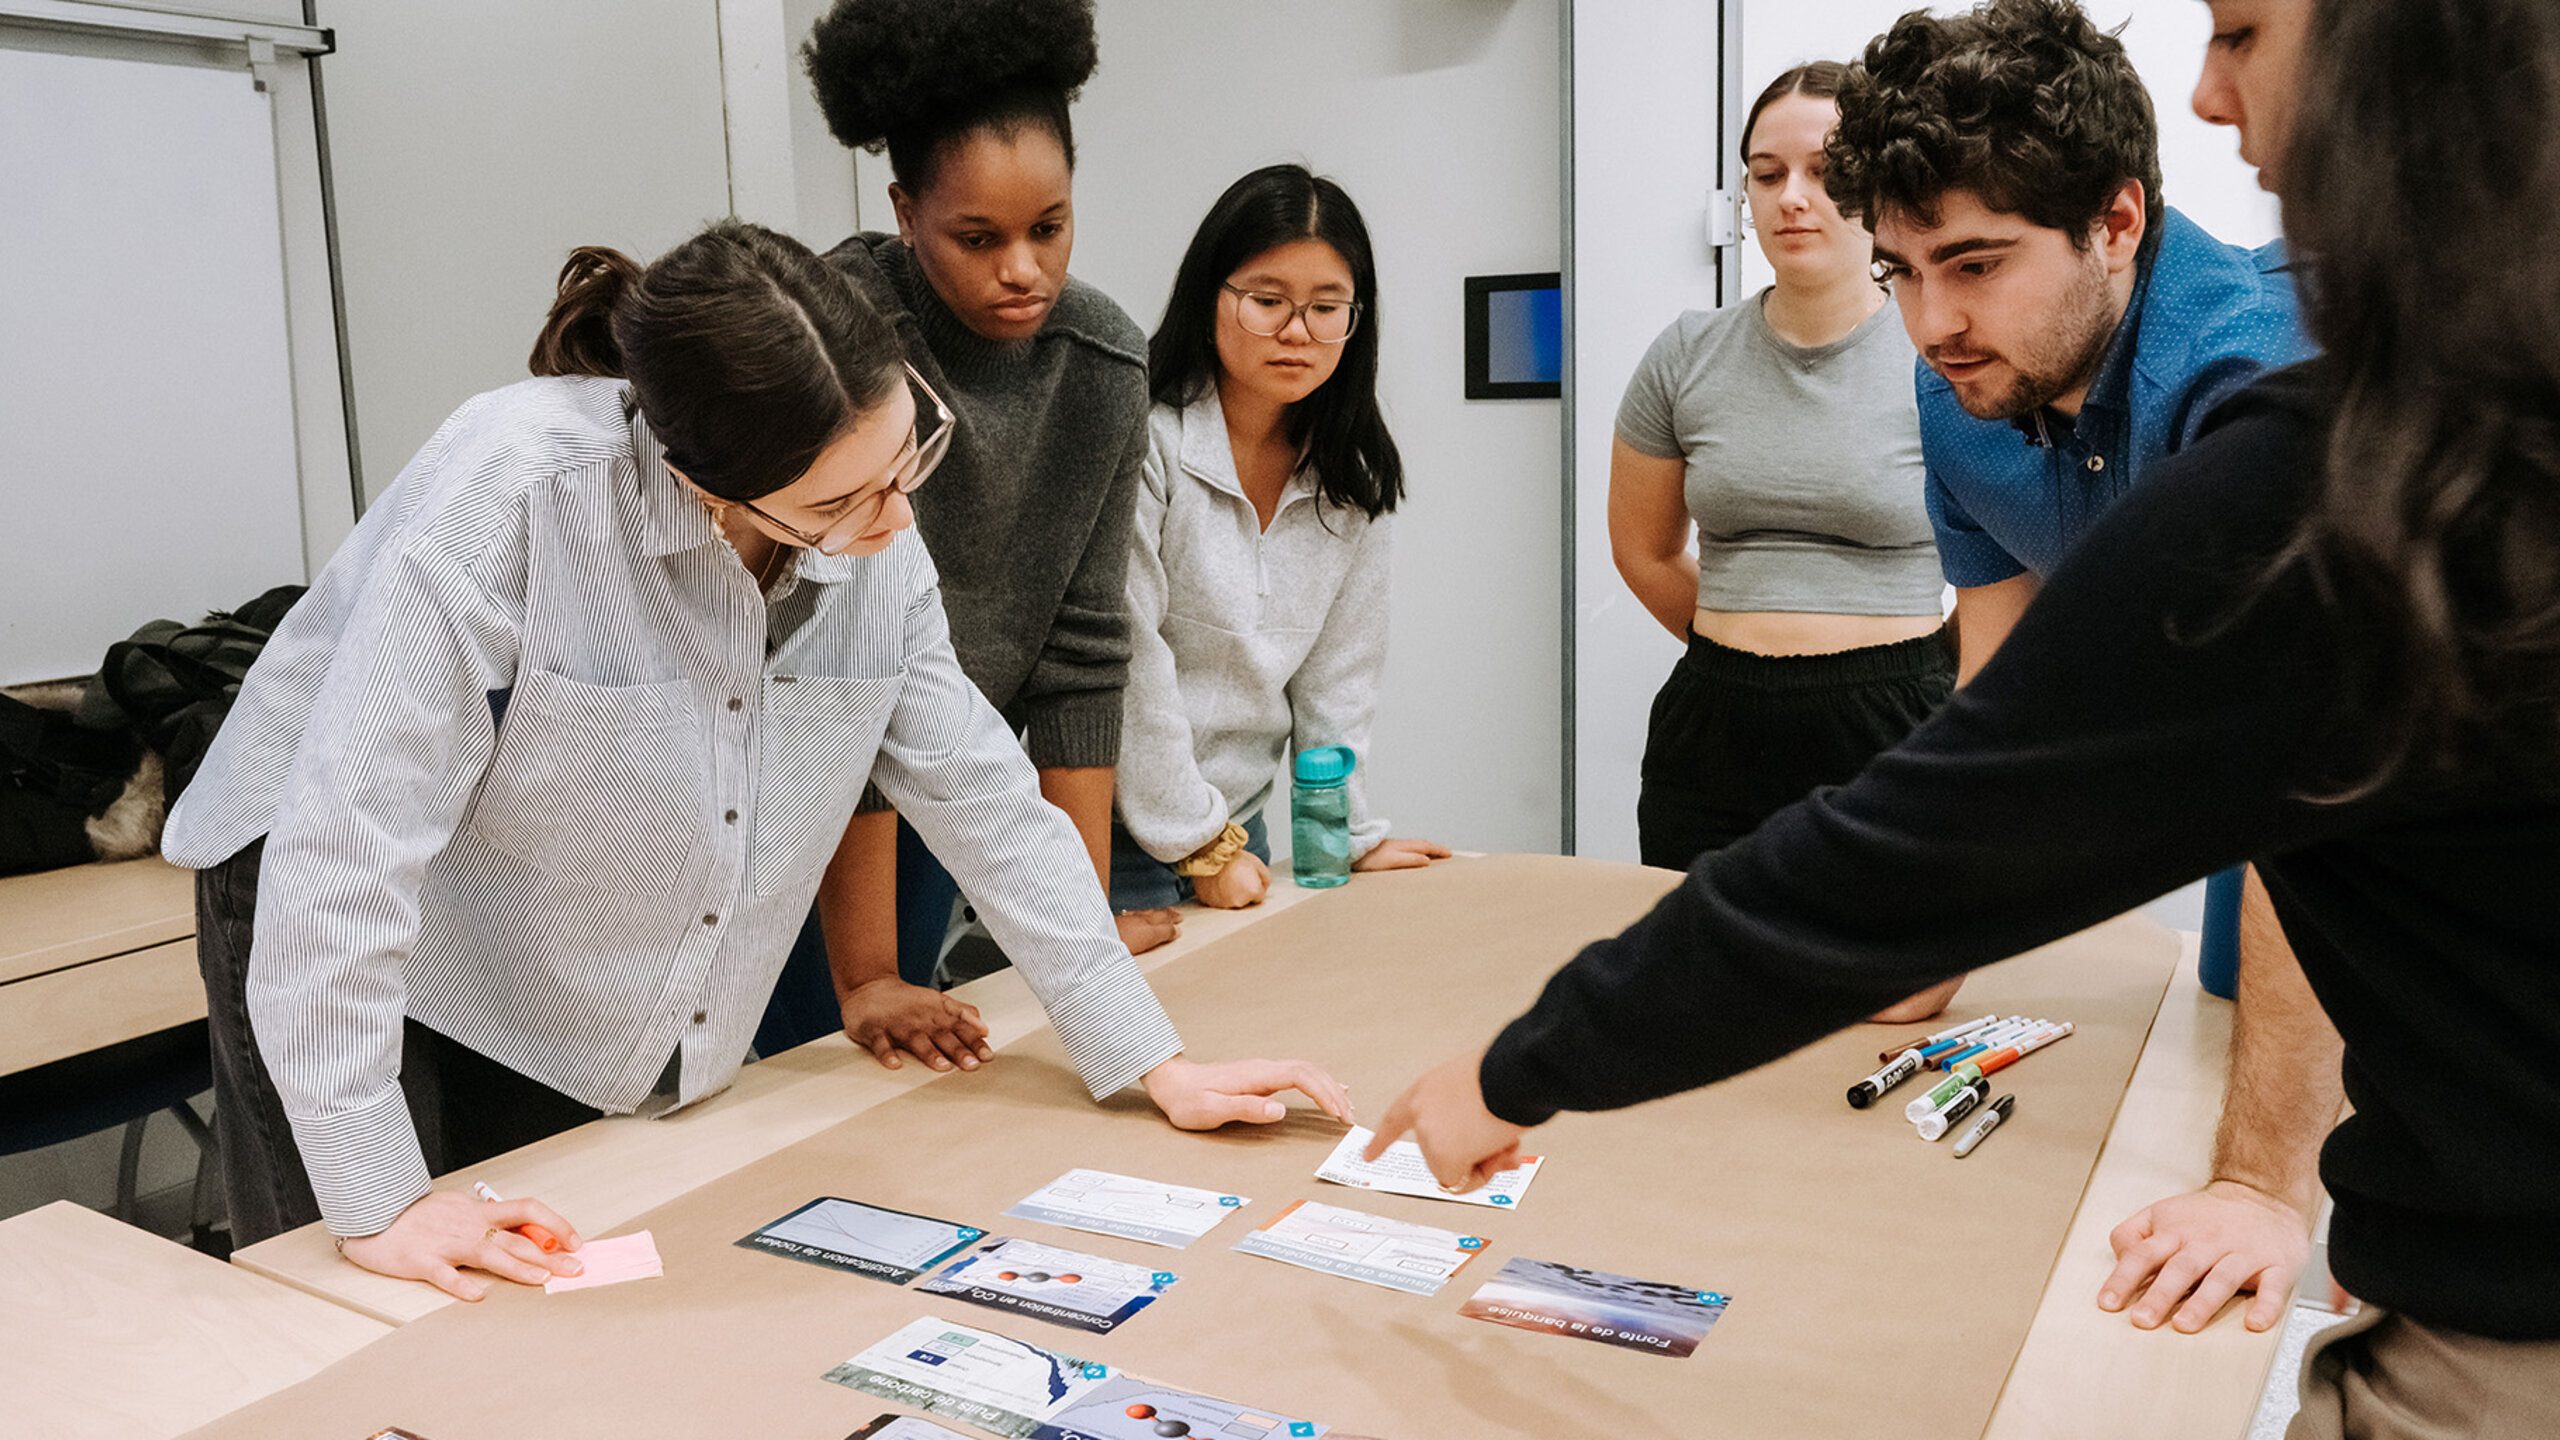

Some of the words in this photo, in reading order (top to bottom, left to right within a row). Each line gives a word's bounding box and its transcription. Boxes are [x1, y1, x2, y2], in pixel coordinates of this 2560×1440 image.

[1040, 1209, 1076, 1223] eaux
[1078, 1217, 1105, 1229] des
[1109, 1221, 1161, 1239] Montée
[754, 1235, 801, 1252] l'océan
[803, 1246, 822, 1257] de
[1244, 1238, 1333, 1268] température
[823, 1252, 907, 1277] Acidification
[1336, 1263, 1350, 1273] la
[1354, 1266, 1375, 1277] de
[1378, 1271, 1438, 1292] Hausse
[999, 1295, 1018, 1305] en
[1018, 1299, 1114, 1329] Concentration
[1487, 1305, 1567, 1329] banquise
[1570, 1322, 1588, 1333] la
[1591, 1326, 1615, 1337] de
[1619, 1330, 1672, 1348] Fonte
[868, 1374, 933, 1400] carbone
[933, 1394, 956, 1408] de
[957, 1401, 1001, 1422] Puits
